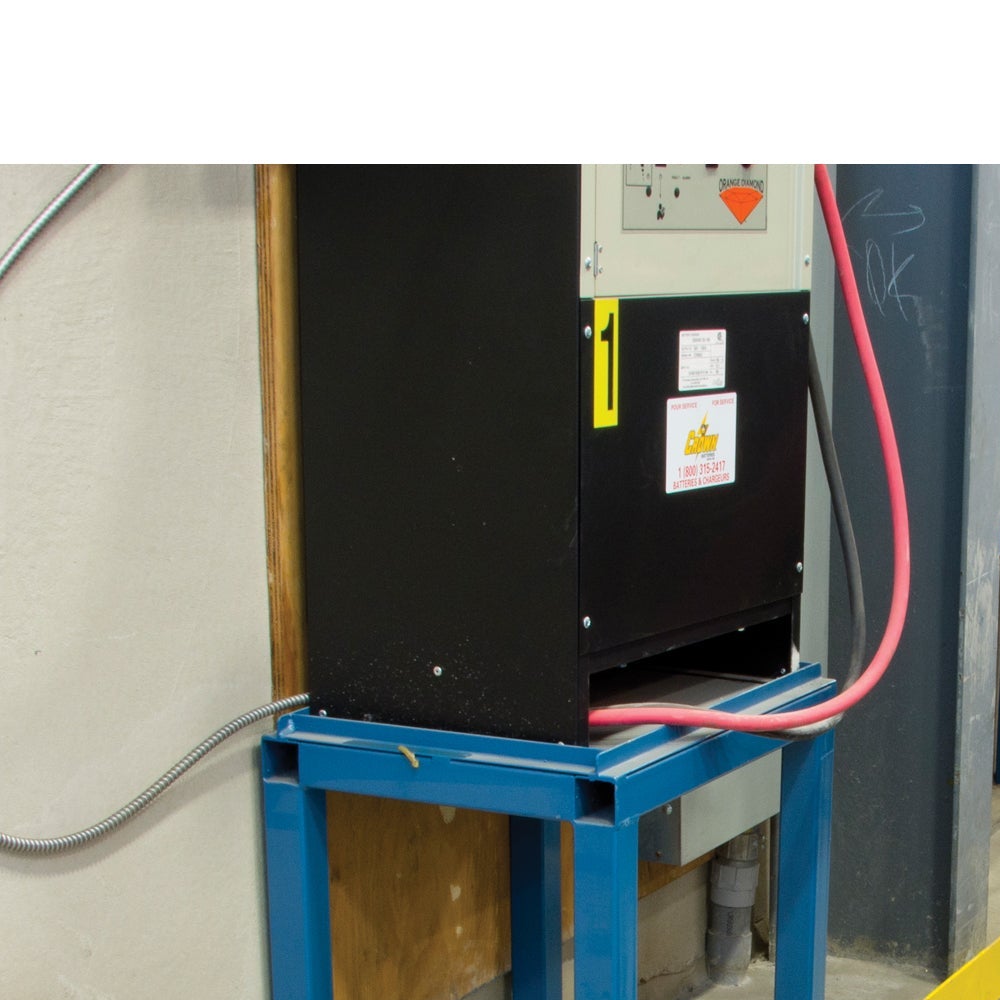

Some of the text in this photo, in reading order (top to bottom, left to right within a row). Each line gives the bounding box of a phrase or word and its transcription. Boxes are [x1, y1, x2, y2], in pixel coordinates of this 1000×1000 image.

[719, 177, 765, 193] ORANGE DIAMOND
[601, 313, 615, 410] 1
[683, 464, 698, 478] (800)
[699, 460, 726, 475] 315-2417
[673, 479, 698, 489] BATTERIES
[703, 473, 730, 485] CHARGEURS
